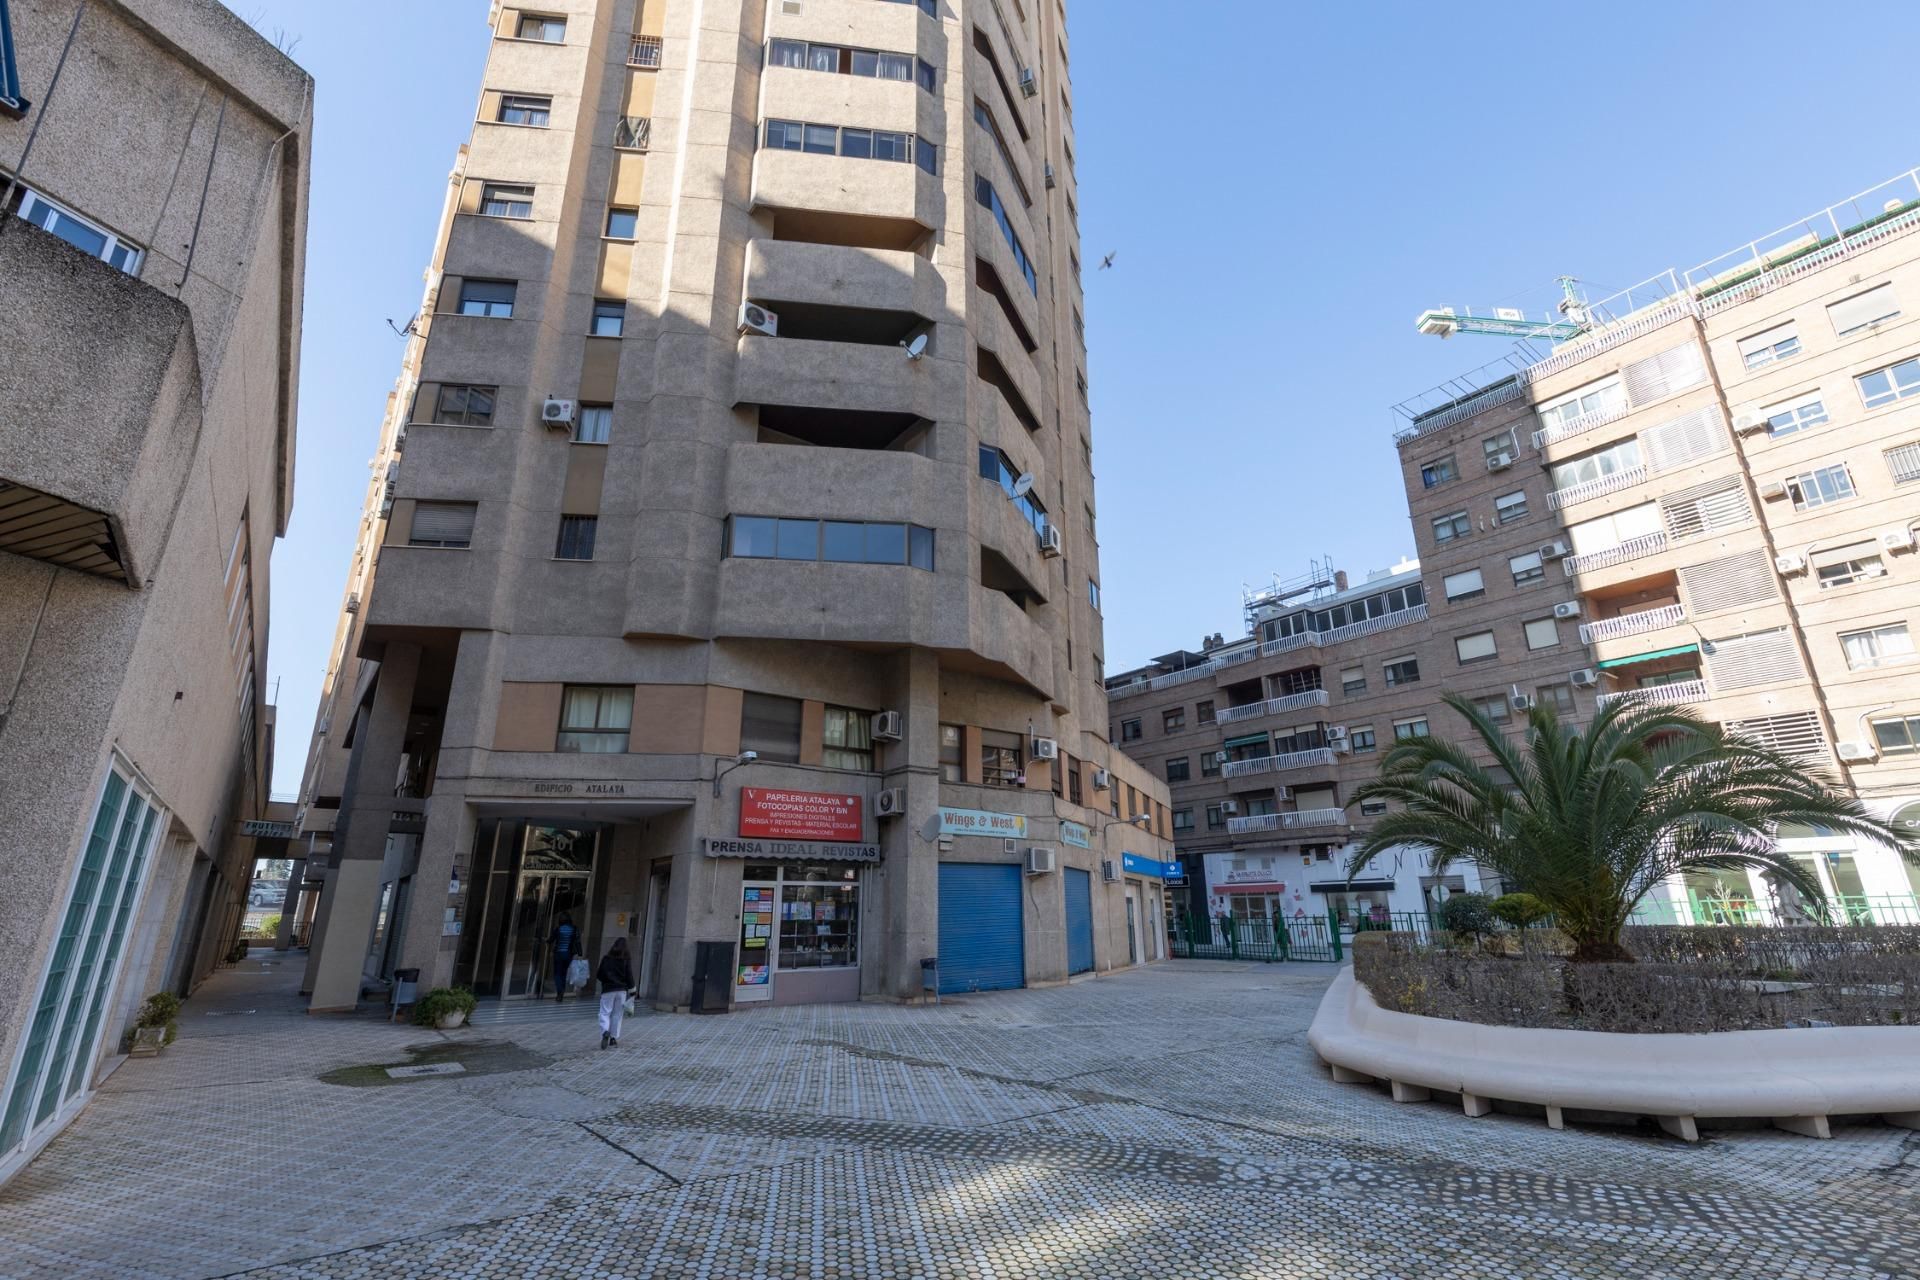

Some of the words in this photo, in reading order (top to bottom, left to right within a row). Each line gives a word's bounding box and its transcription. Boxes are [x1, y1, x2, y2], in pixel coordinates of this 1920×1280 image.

[535, 784, 573, 793] EDIFICIO
[766, 793, 808, 803] PAPELERIA
[808, 796, 840, 805] ATALAYA
[757, 802, 804, 812] FOTOCOPIAS
[770, 812, 808, 820] IMPRESIONES
[808, 814, 836, 822] DIGITALES
[944, 812, 975, 828] Wings
[978, 816, 987, 826] &
[990, 816, 1016, 830] West
[551, 837, 574, 851] 101
[711, 840, 763, 854] PRENSA
[770, 842, 817, 856] IDEAL
[822, 845, 876, 858] REVISTAS
[525, 862, 555, 870] CAMINO
